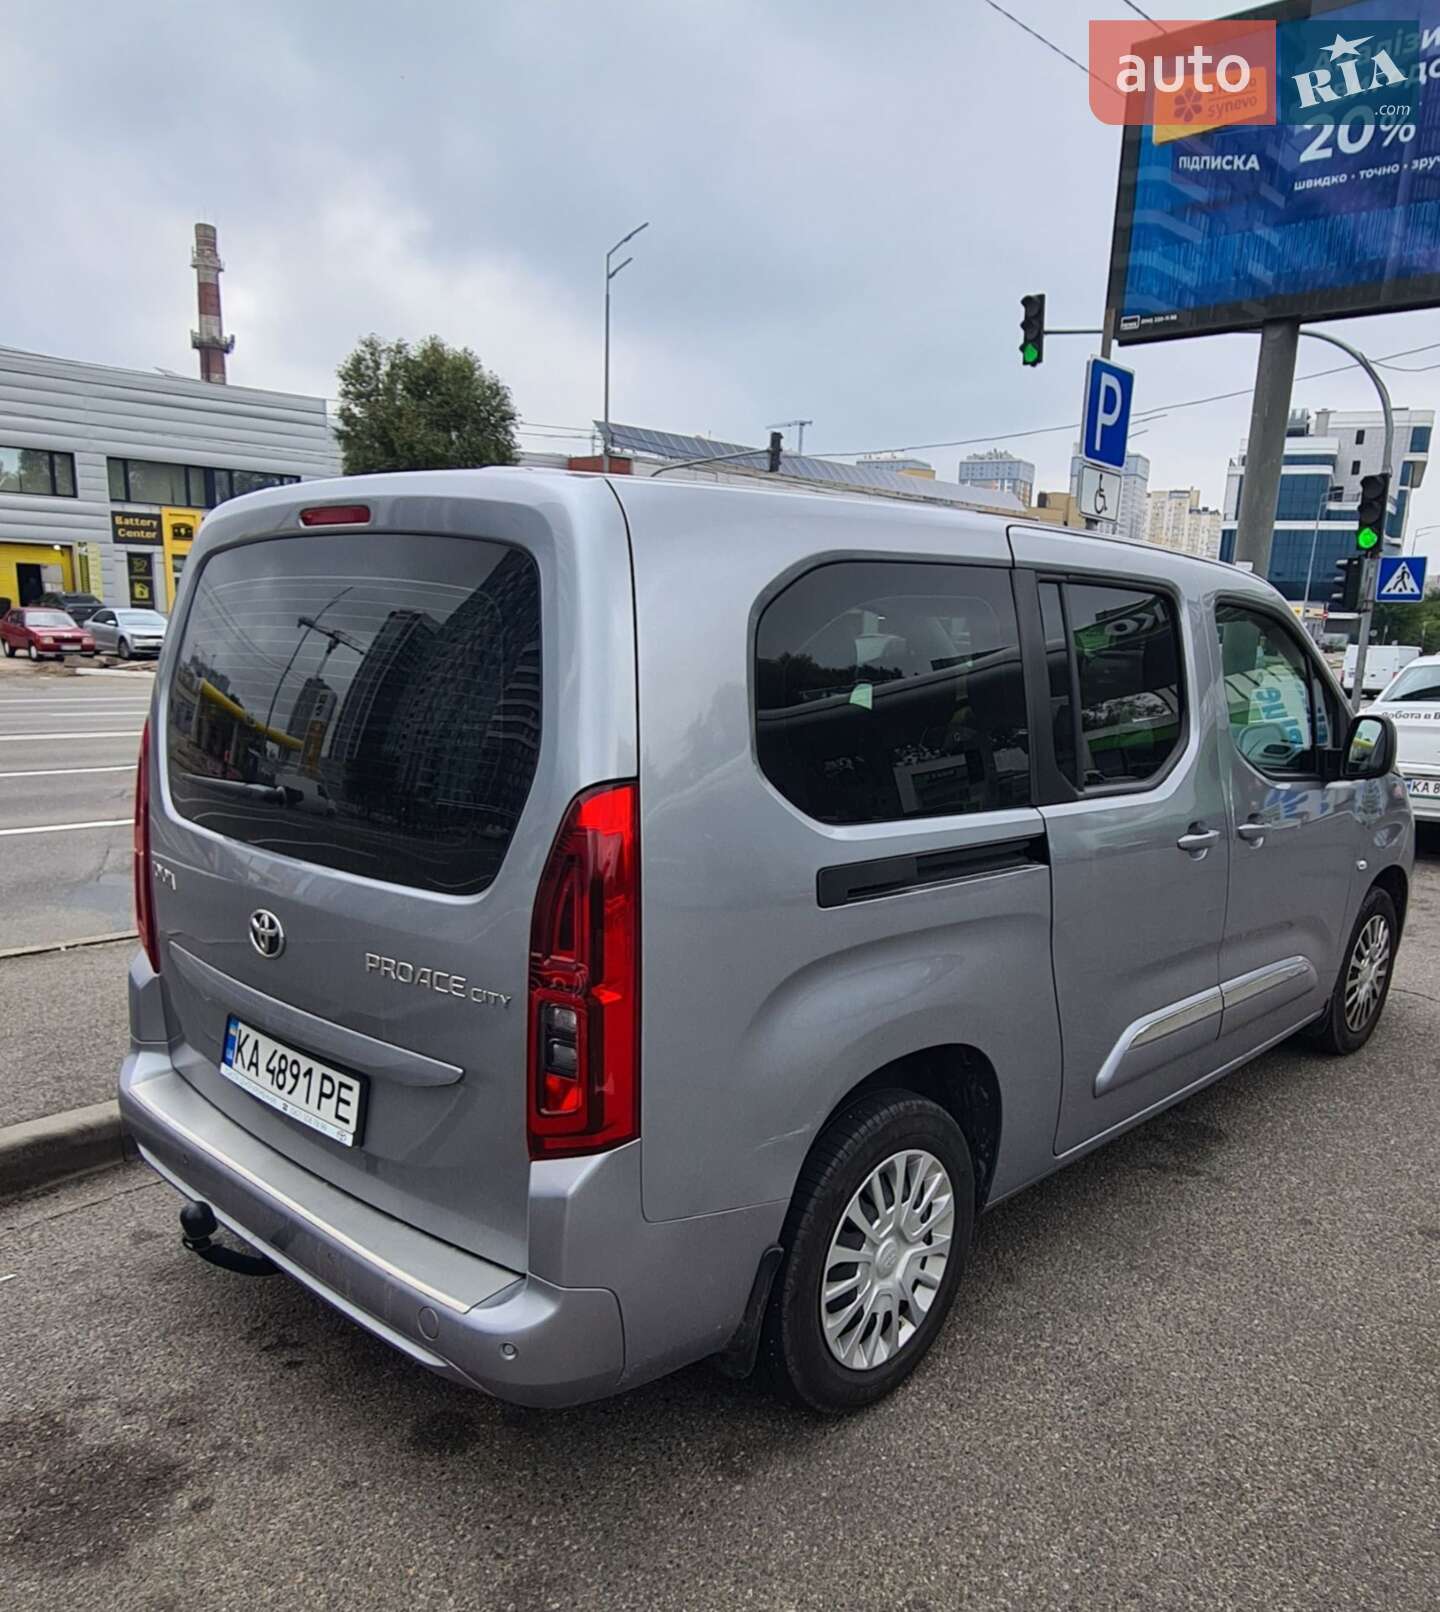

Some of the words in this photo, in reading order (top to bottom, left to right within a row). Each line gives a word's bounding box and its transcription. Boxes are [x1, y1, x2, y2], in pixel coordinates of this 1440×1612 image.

[1300, 105, 1417, 163] 20%
[1293, 173, 1348, 192] швидко
[1359, 163, 1400, 180] точно
[1095, 371, 1122, 451] P
[114, 515, 158, 528] Battery
[117, 528, 158, 539] Center
[365, 952, 467, 998] PROACE
[471, 987, 513, 1005] CITY
[235, 1028, 260, 1078] KA
[265, 1049, 314, 1105] 4891
[317, 1072, 354, 1125] PE
